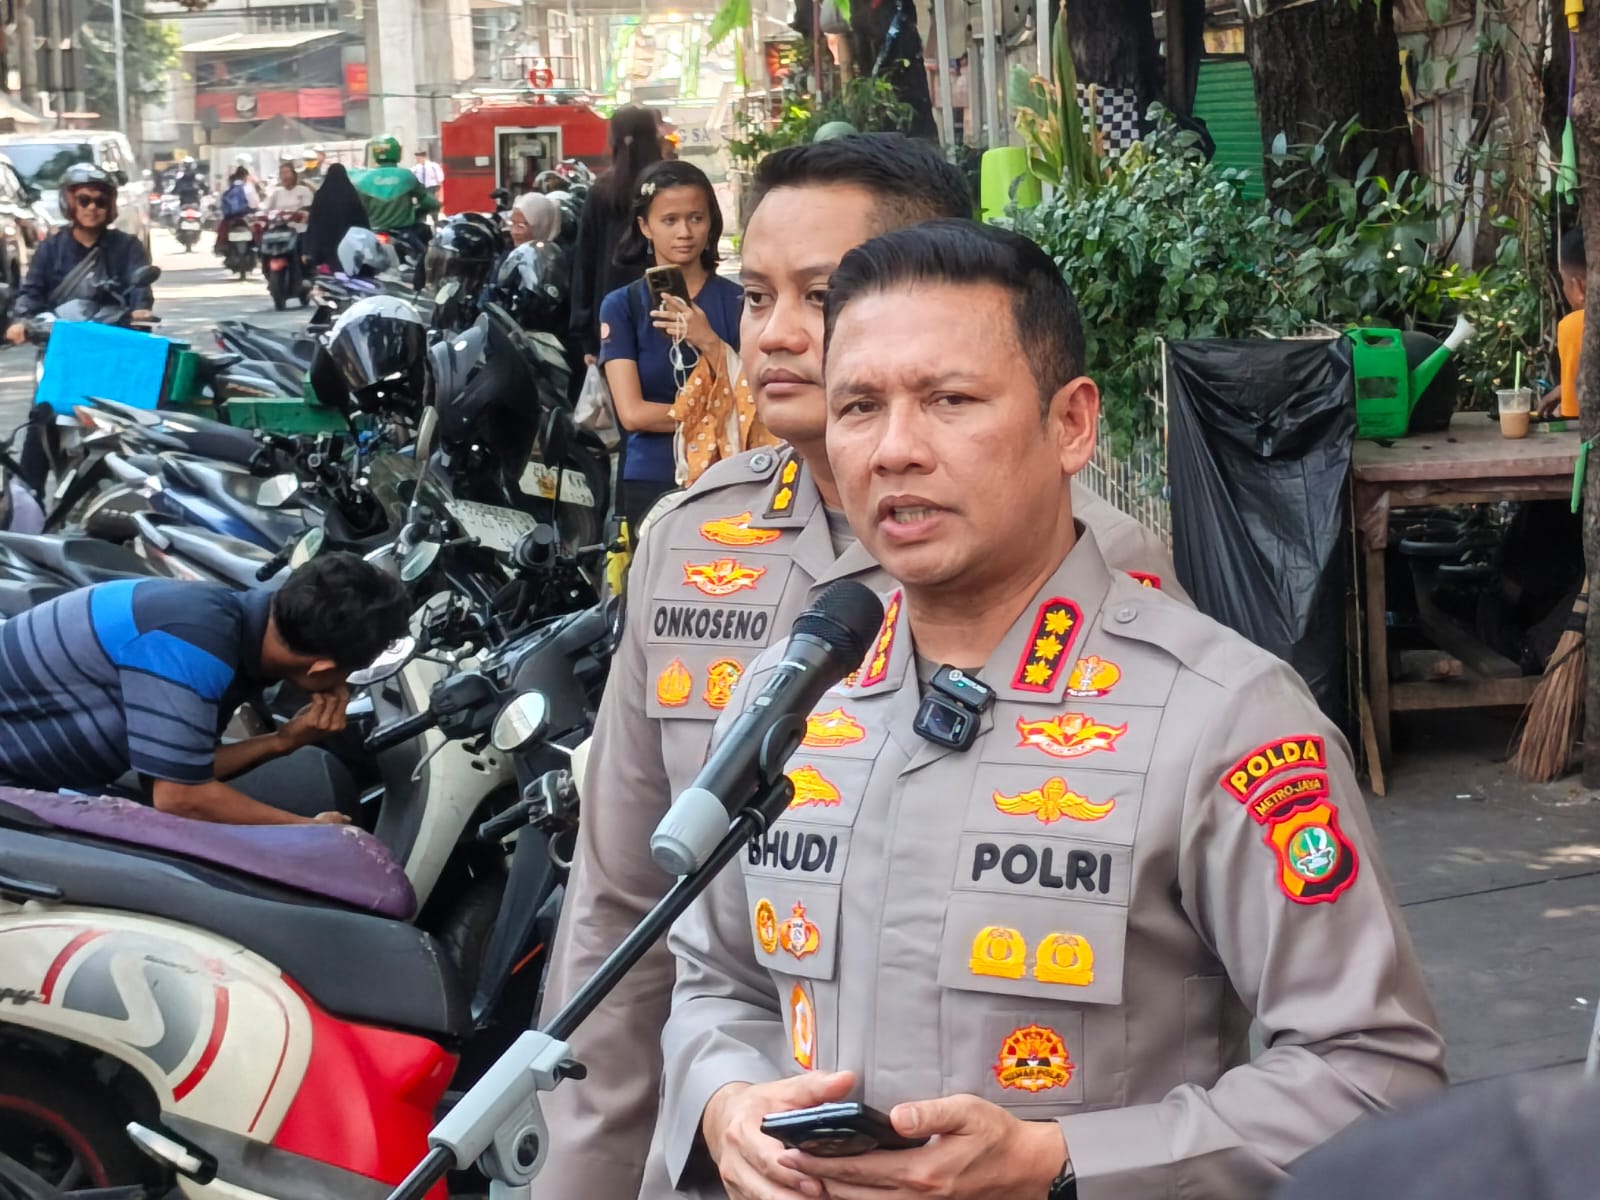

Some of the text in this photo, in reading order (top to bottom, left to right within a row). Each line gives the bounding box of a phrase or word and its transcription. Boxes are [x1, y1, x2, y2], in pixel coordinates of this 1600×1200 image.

[654, 606, 768, 640] ONKOSENO
[1230, 740, 1319, 794] POLDA
[1255, 778, 1321, 816] METRO JAYA
[747, 830, 837, 873] BHUDI
[972, 843, 1112, 894] POLRI
